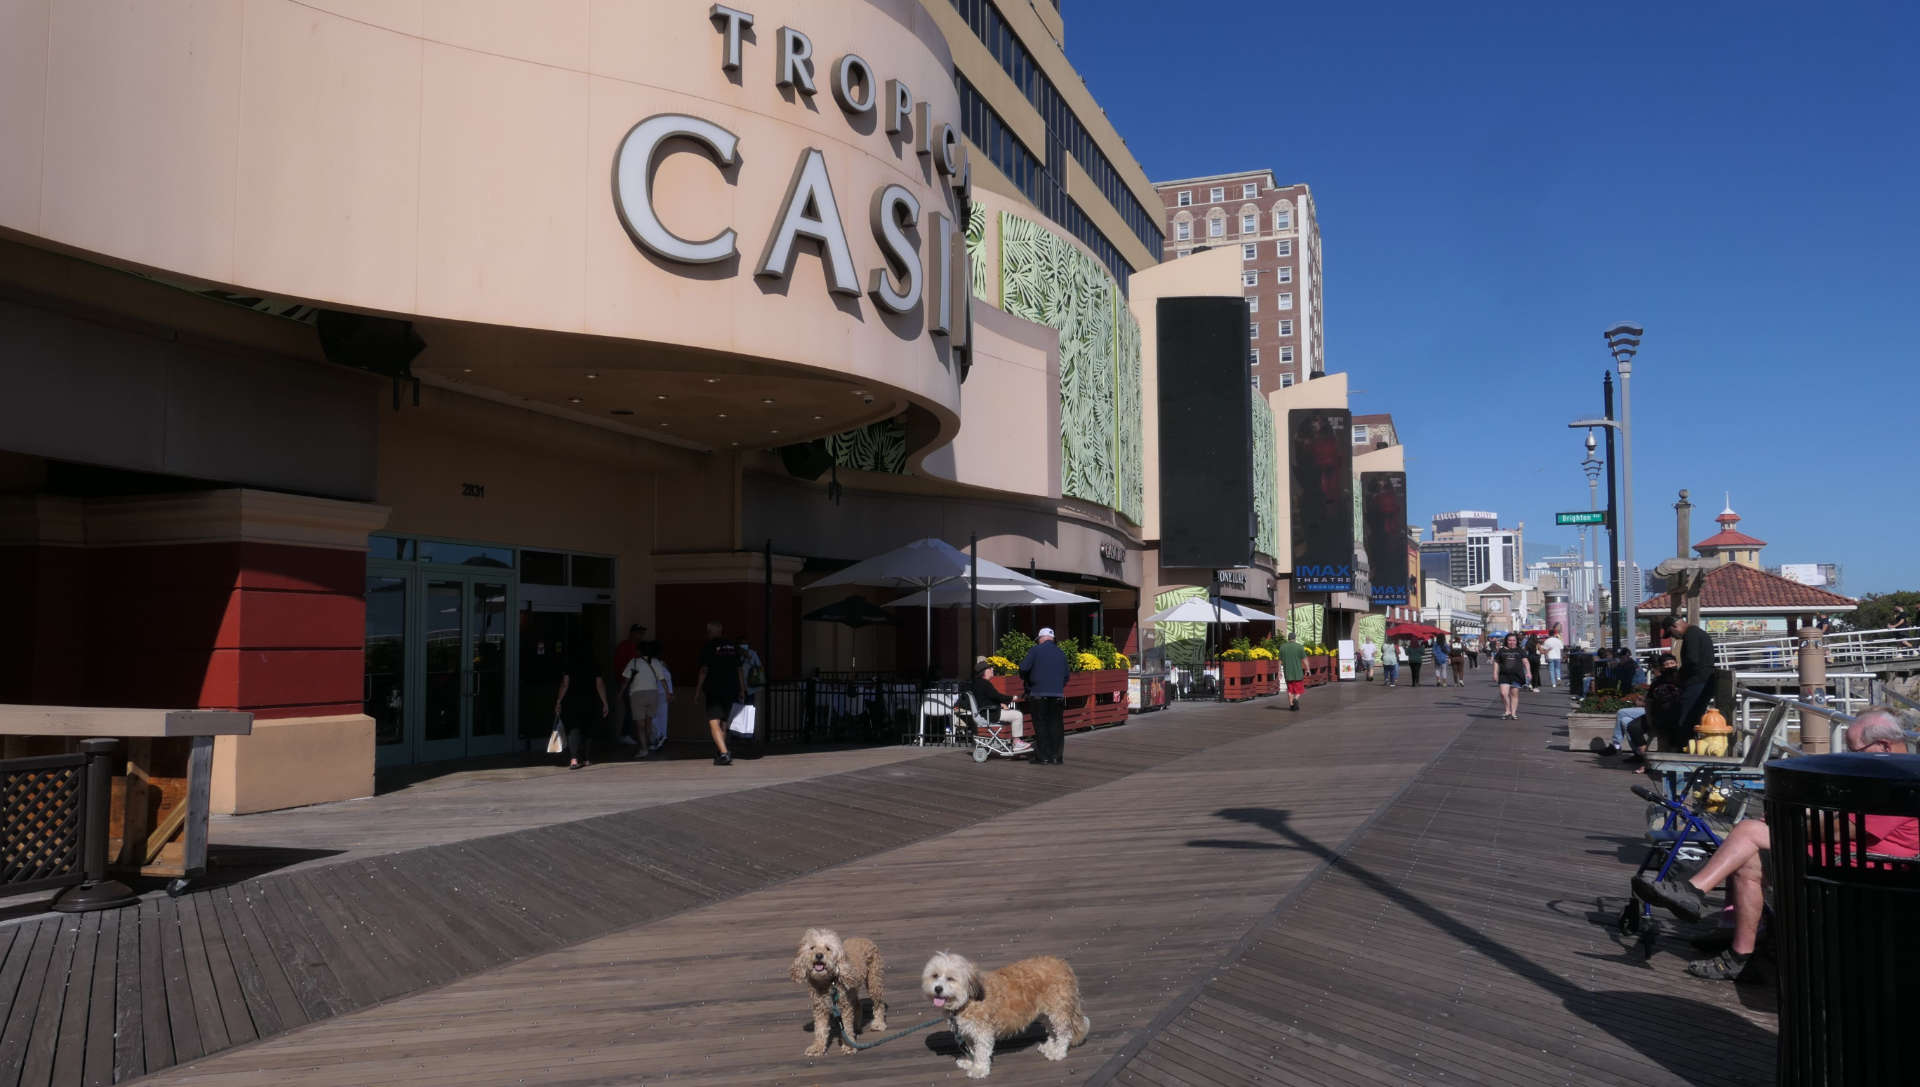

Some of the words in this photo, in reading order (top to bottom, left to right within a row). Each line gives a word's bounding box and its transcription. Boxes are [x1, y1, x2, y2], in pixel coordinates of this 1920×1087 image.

[709, 3, 970, 192] TROPIC
[611, 113, 971, 365] CASI
[462, 484, 484, 498] 2831
[1562, 514, 1591, 523] Brighton
[1296, 565, 1351, 576] IMAX
[1370, 585, 1406, 594] MAX
